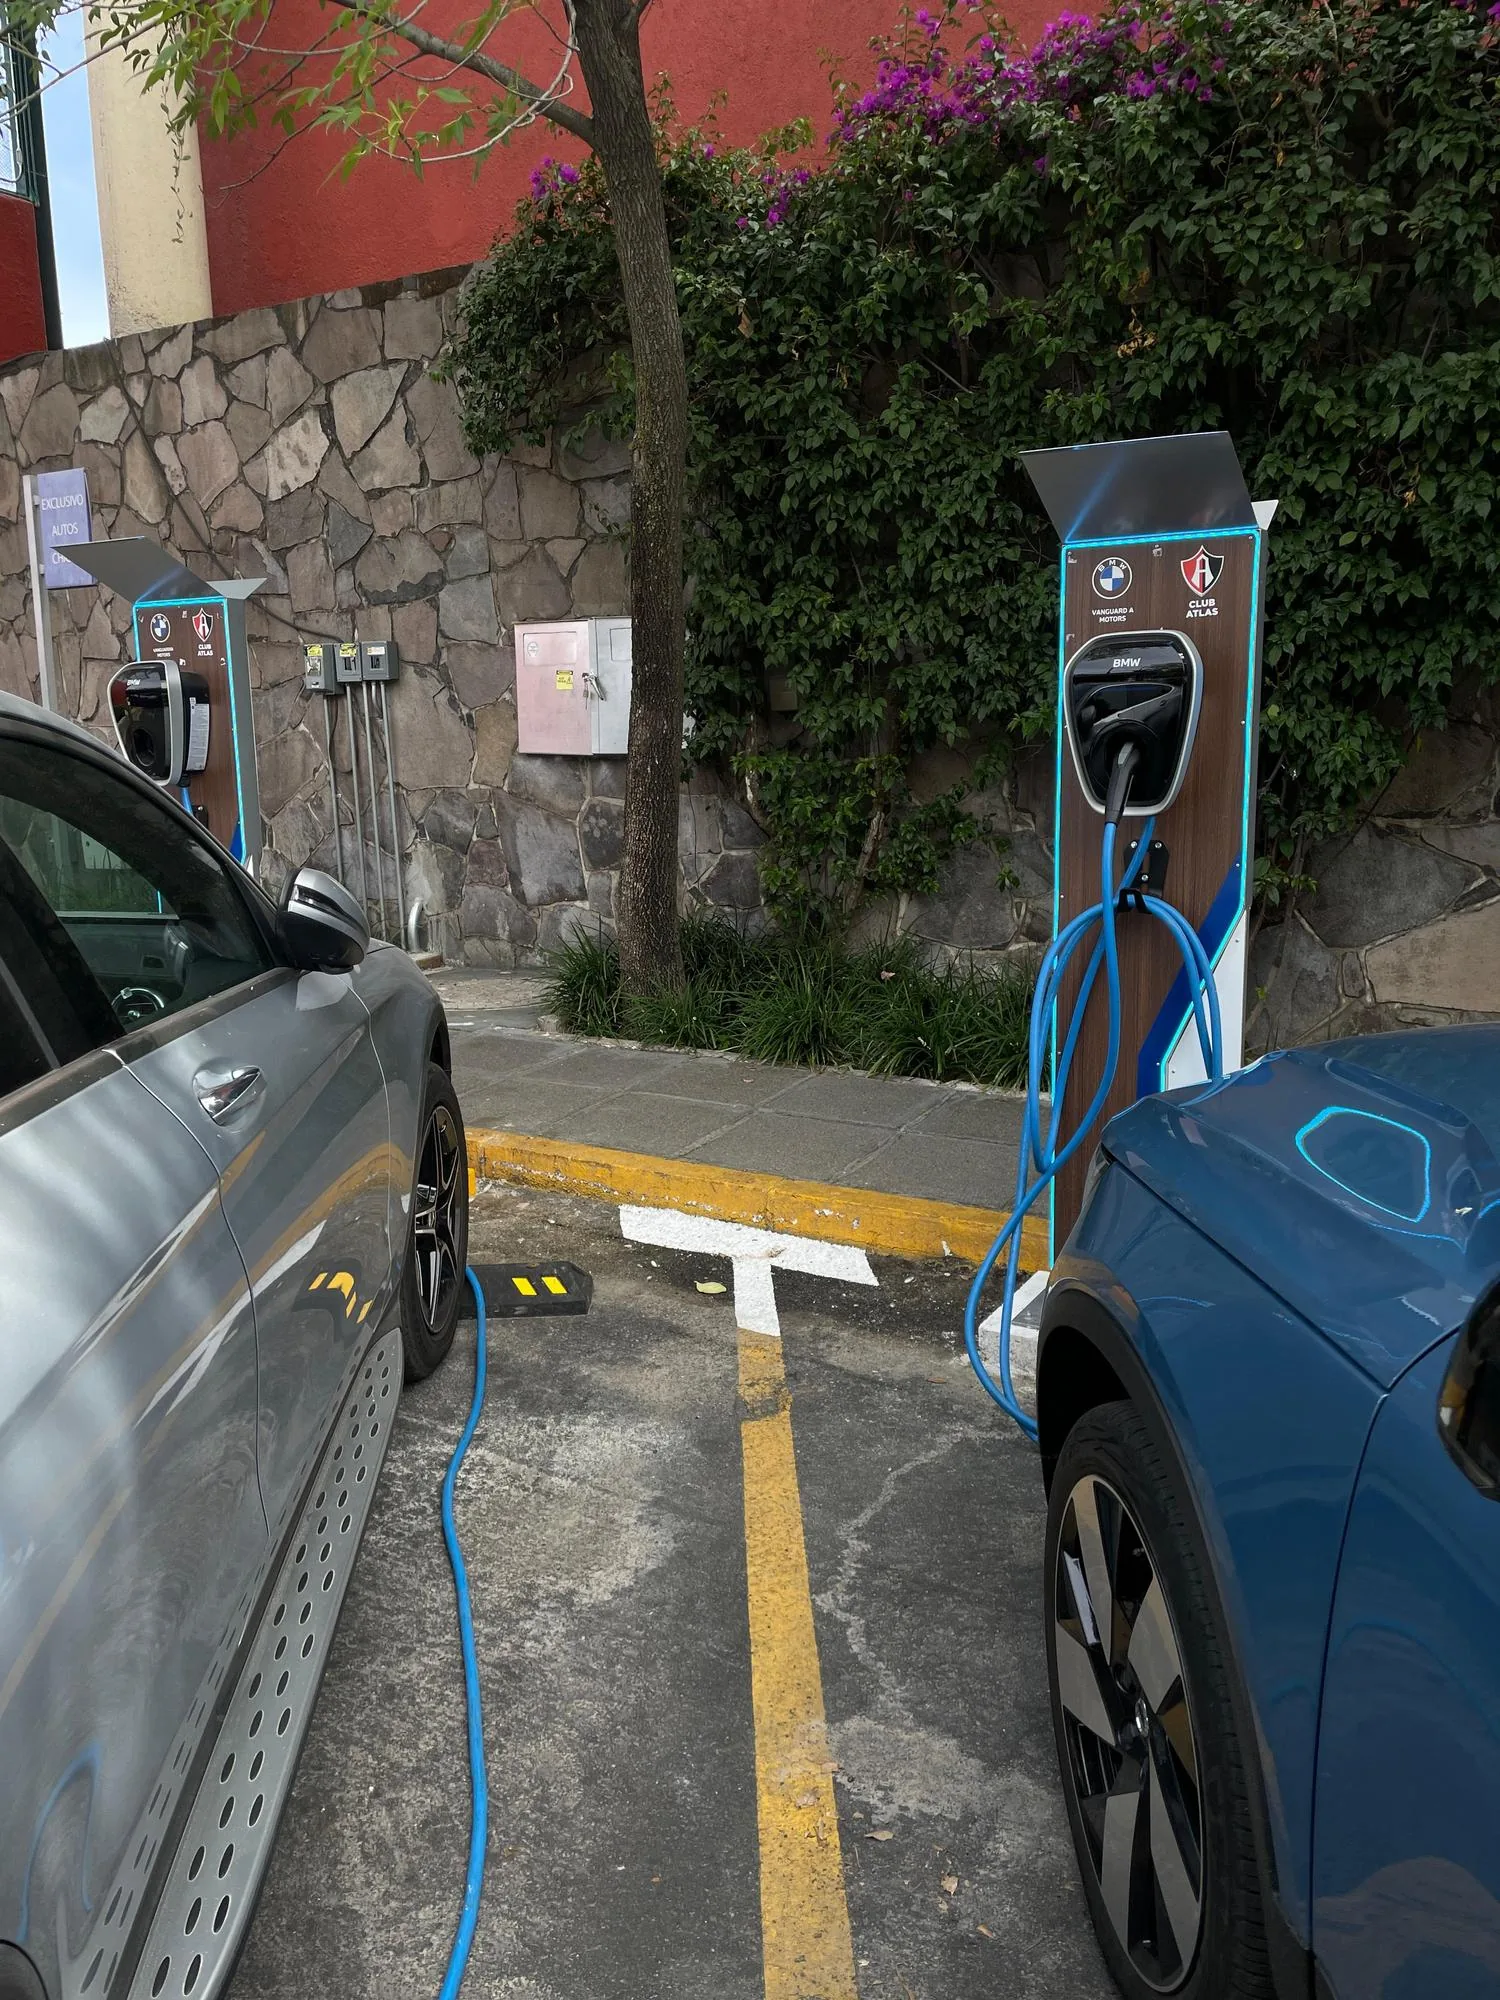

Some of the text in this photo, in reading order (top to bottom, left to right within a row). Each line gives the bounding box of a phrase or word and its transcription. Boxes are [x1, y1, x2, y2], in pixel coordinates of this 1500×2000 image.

[41, 494, 84, 511] EXCLUSIVO
[52, 522, 79, 537] AUTOS
[1098, 559, 1127, 572] BMW
[1188, 598, 1216, 608] CLUB
[1186, 608, 1219, 618] ATLAS
[1099, 615, 1127, 623] MOTORS
[1113, 658, 1141, 668] BMW
